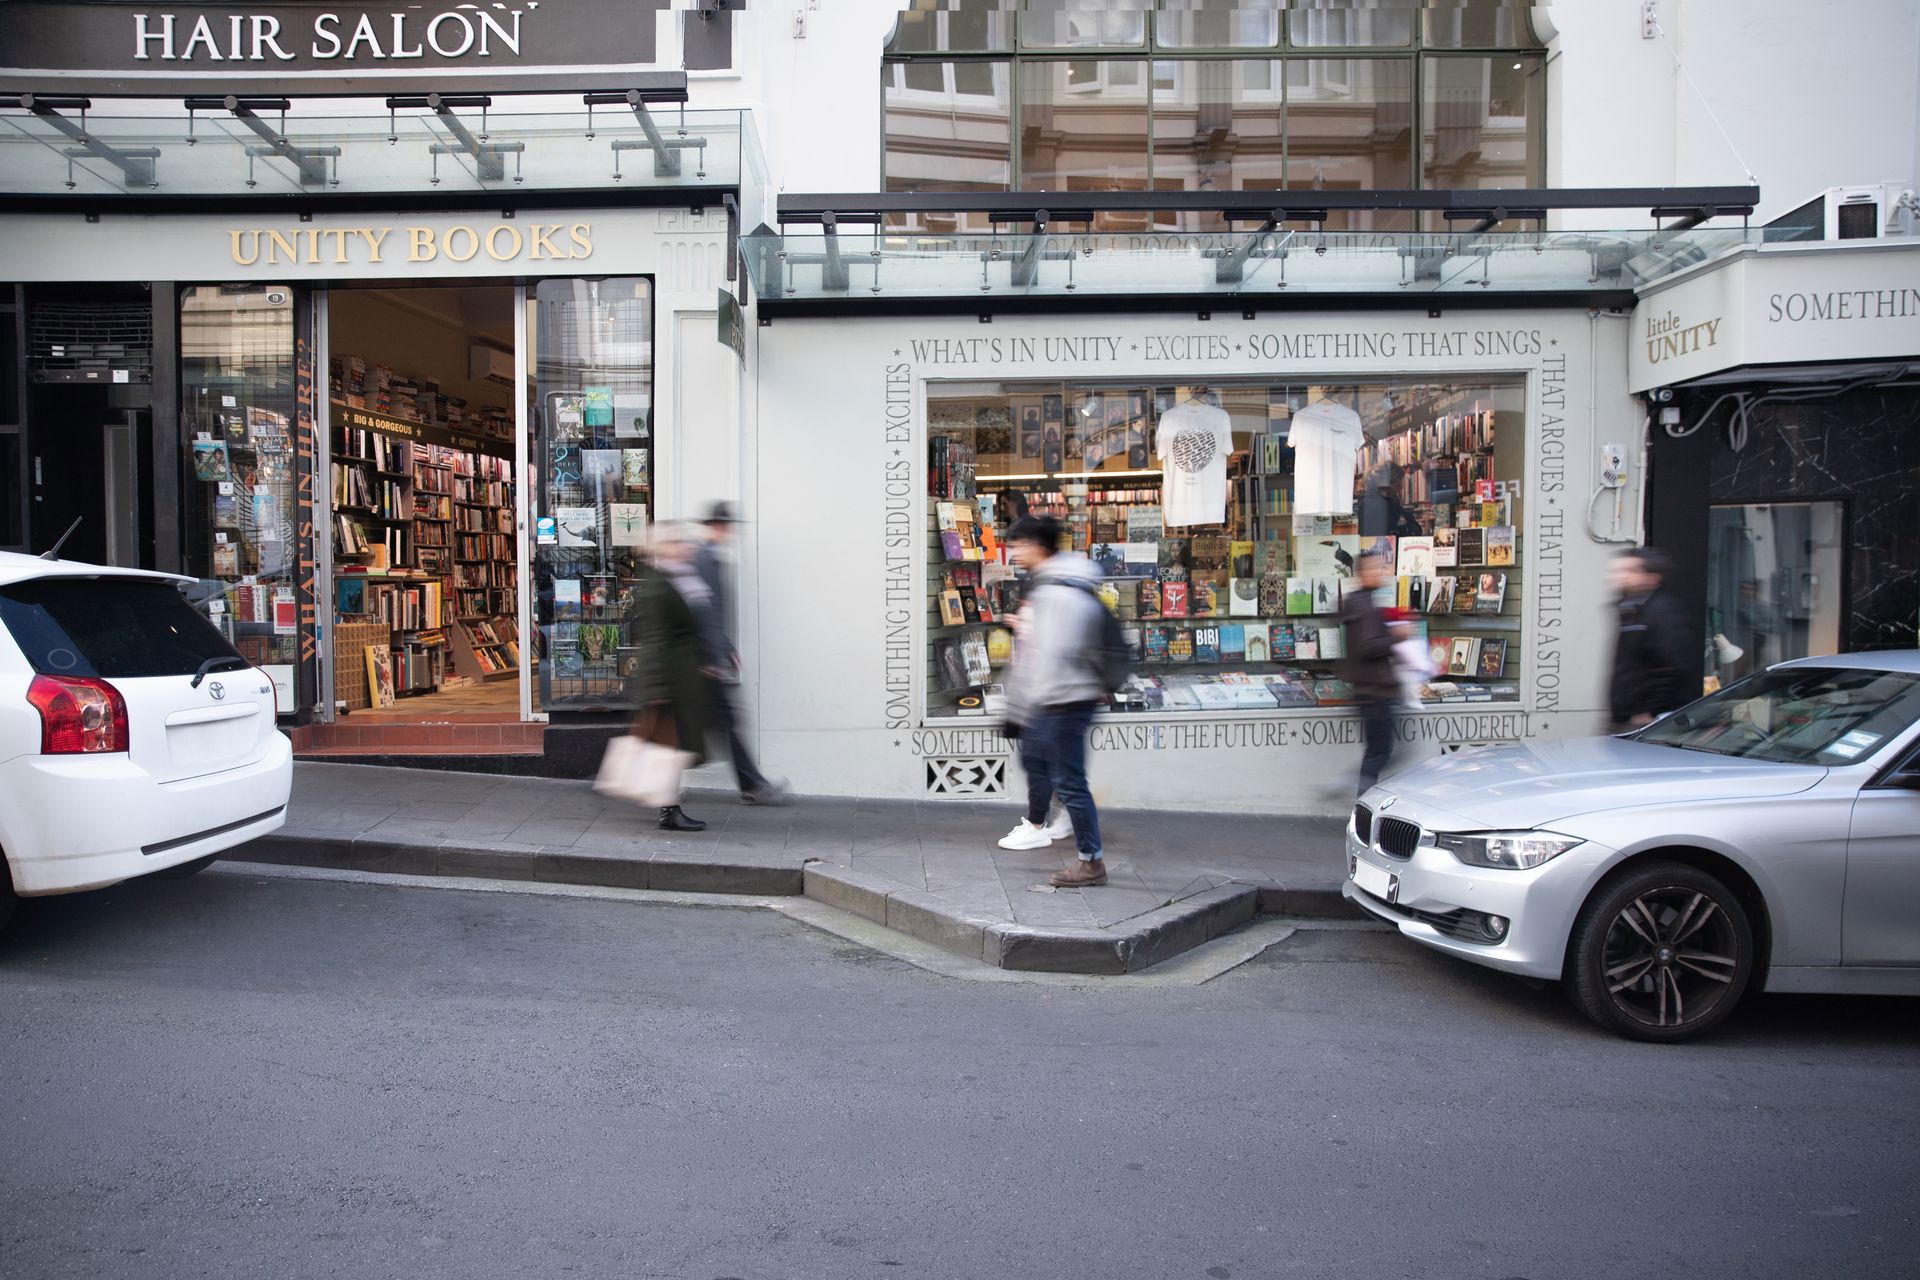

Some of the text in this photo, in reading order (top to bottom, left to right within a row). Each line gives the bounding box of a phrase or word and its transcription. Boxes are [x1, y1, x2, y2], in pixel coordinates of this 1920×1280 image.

[134, 9, 524, 61] HAIR SALON
[227, 222, 594, 267] UNITY BOOKS
[910, 330, 1542, 364] WHAT'S IN UNITY EXCITES SOMETHING THAT SINGS
[1646, 310, 1680, 338] little
[1647, 317, 1722, 365] UNITY
[354, 413, 413, 435] BIG & GORGEOUS
[297, 338, 316, 663] WHAT'S IN HERE?
[885, 362, 911, 730] SOMETHING THAT SEDUCES EXCITES
[1536, 353, 1566, 715] THAT ARGUES THAT TELLS A STORY
[912, 729, 1025, 755] SOMETHIN
[1090, 726, 1130, 752] CAN
[1170, 724, 1210, 749] THE
[1214, 722, 1288, 748] FUTURE
[1302, 717, 1417, 745] SOMETNG
[1419, 714, 1536, 742] WONDERFUL
